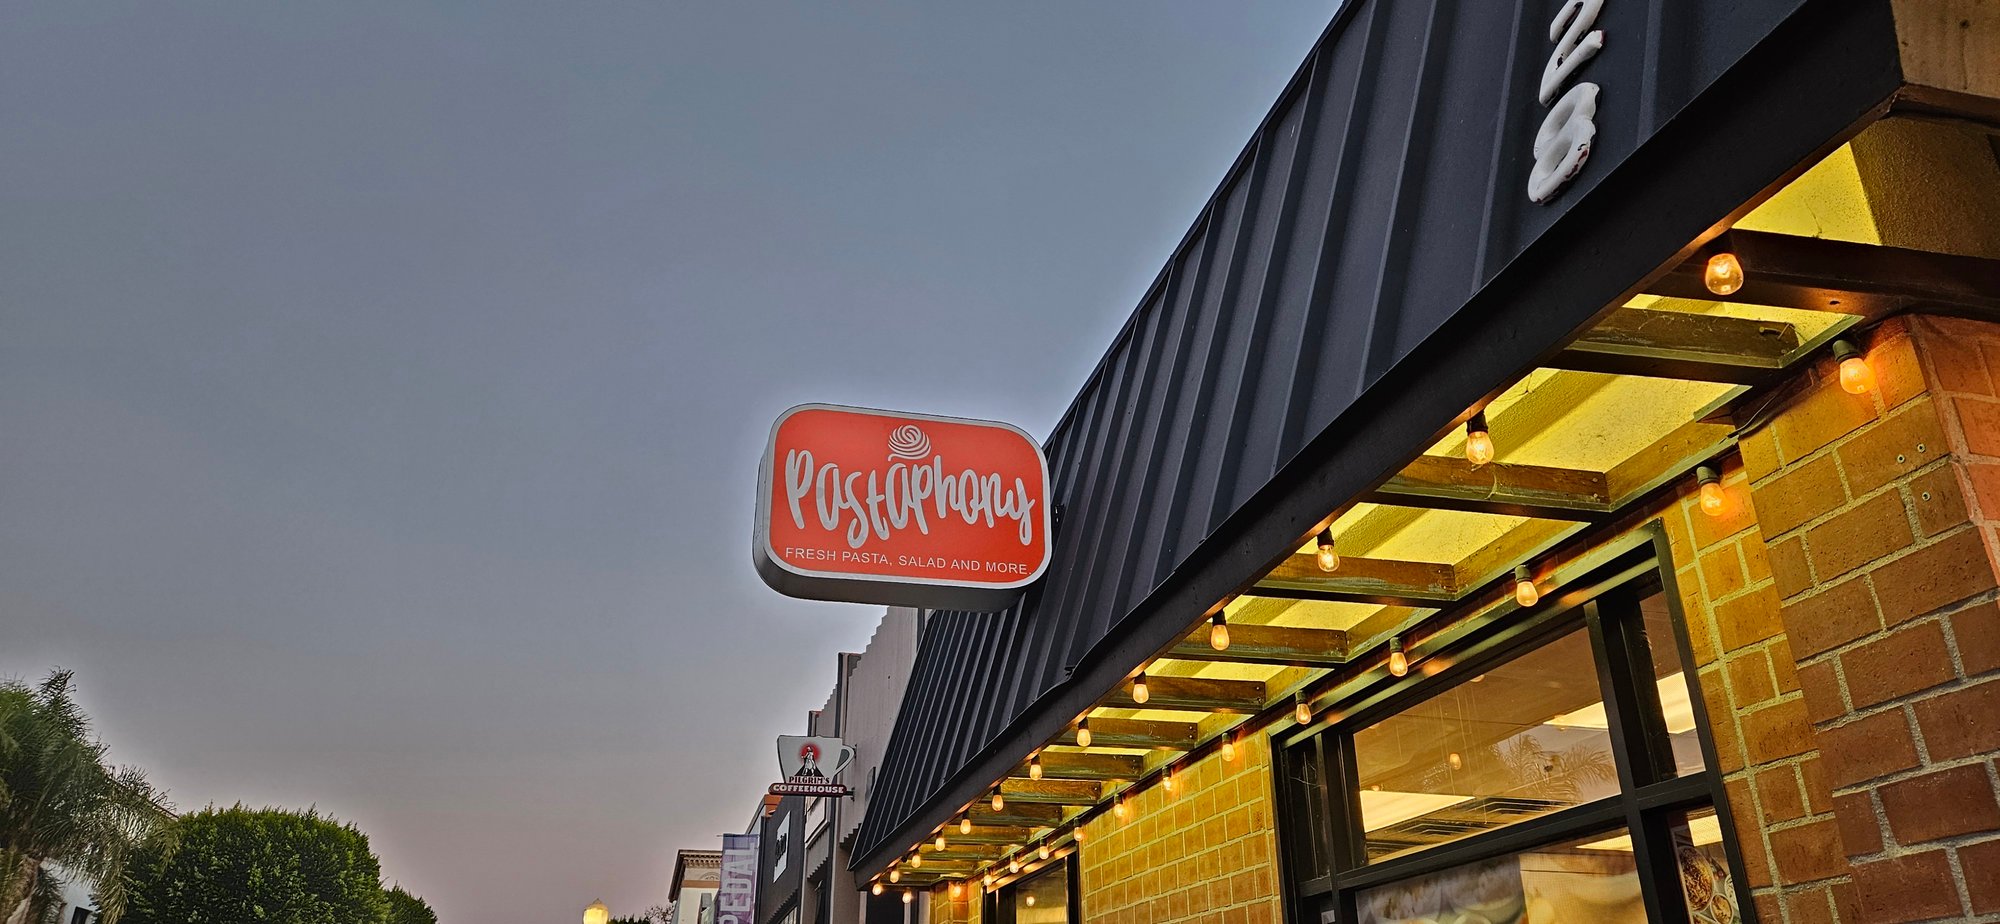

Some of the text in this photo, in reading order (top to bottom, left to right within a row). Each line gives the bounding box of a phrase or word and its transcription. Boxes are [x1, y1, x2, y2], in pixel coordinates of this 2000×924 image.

[785, 449, 1035, 548] Pastaphony
[785, 547, 836, 561] FRESH
[842, 551, 893, 567] PASTA,
[898, 555, 946, 569] SALAD
[950, 559, 981, 572] AND
[788, 776, 830, 784] PILGRIM'S
[773, 784, 844, 794] COFFEEHOUSE
